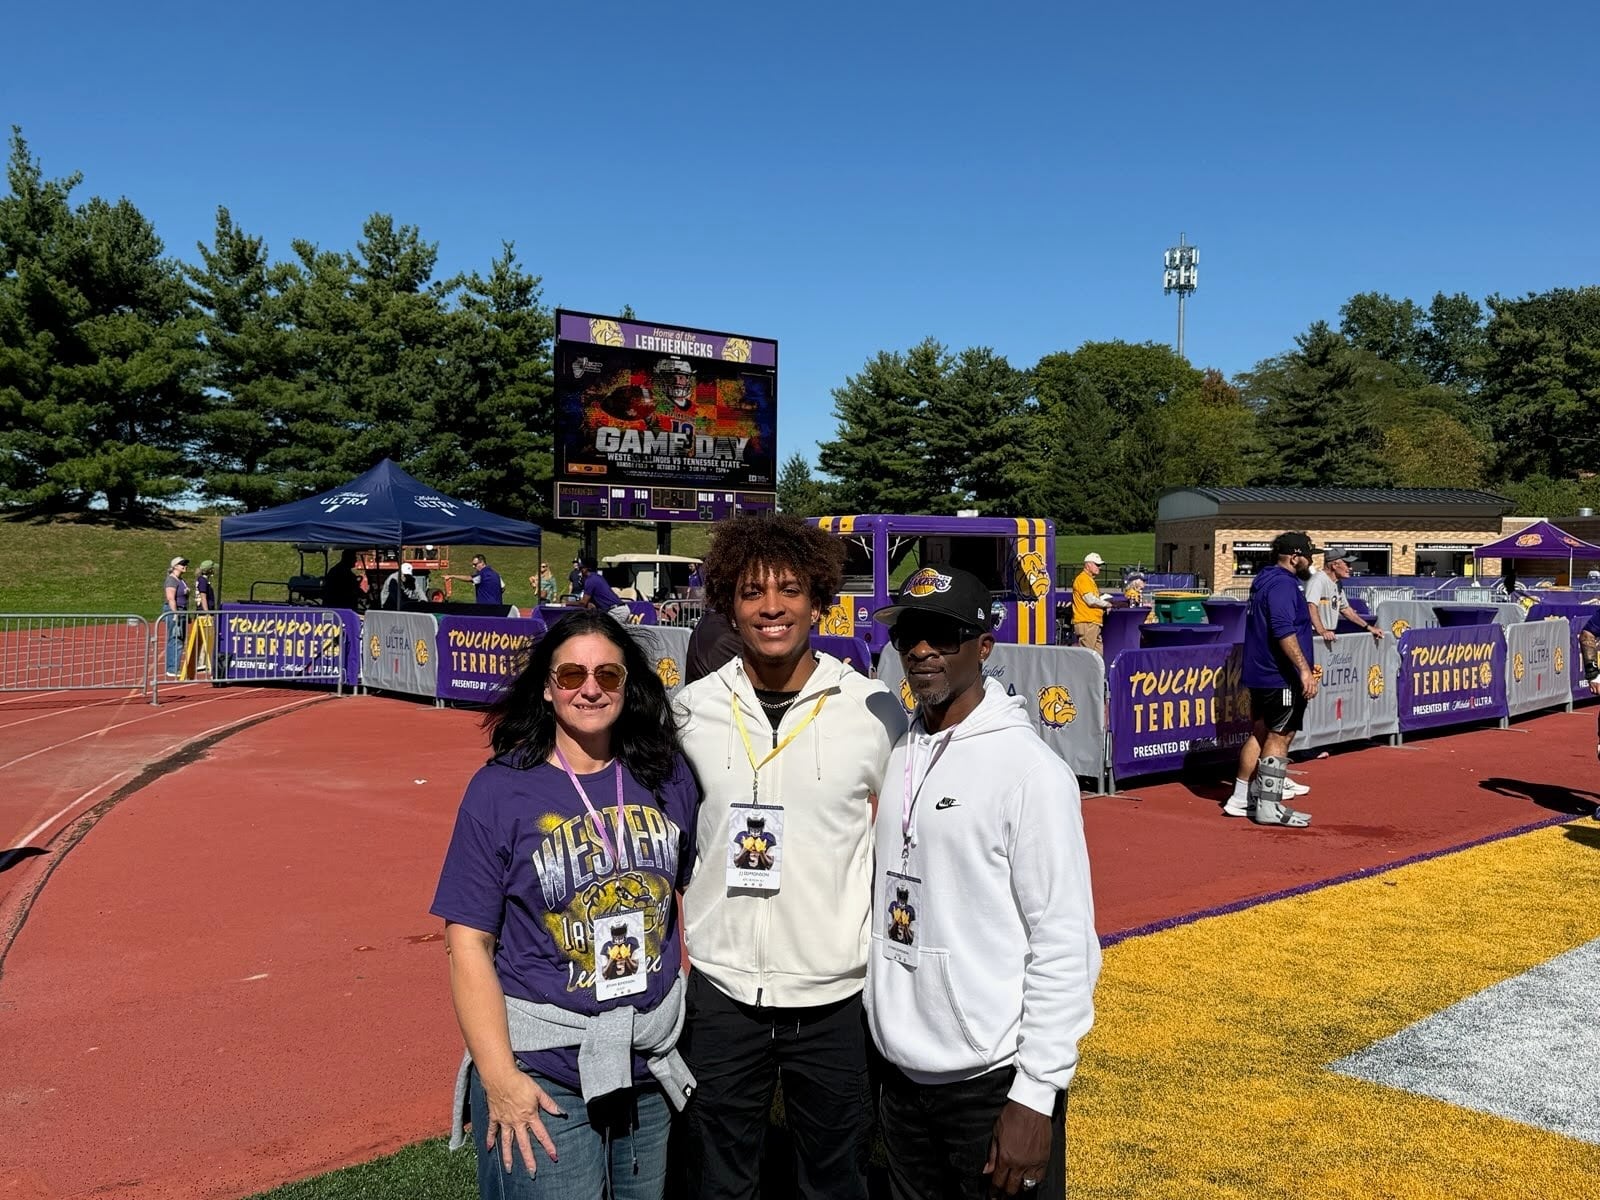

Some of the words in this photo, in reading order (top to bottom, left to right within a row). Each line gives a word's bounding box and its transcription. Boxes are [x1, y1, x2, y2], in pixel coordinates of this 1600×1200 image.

[653, 328, 674, 337] Home
[675, 332, 684, 340] of
[684, 332, 697, 341] the
[635, 334, 713, 358] LEATHERNECKS
[595, 427, 689, 456] GAME
[695, 434, 750, 462] DAY
[672, 456, 681, 465] VS
[683, 458, 719, 468] TENNESSEE
[720, 460, 740, 469] STATE
[320, 497, 369, 506] ULTRA
[699, 505, 714, 520] 25
[229, 616, 341, 638] TOUCHDOWN
[232, 636, 319, 658] TERRACE
[385, 635, 411, 650] ULTRA
[451, 651, 517, 676] TERRACE
[1411, 641, 1496, 668] TOUCHDOWN
[1528, 647, 1550, 664] ULTRA
[451, 679, 479, 689] PRESENTED
[479, 682, 487, 690] BY
[1321, 667, 1359, 687] ULTRA
[1413, 666, 1478, 696] TERRACE
[1133, 695, 1233, 734] TERRACE
[1413, 703, 1442, 715] PRESENTED
[1442, 702, 1450, 711] BY
[1474, 696, 1493, 707] ULTRA
[1133, 741, 1178, 758] PRESENTED
[1179, 740, 1190, 751] BY
[562, 916, 586, 951] 18
